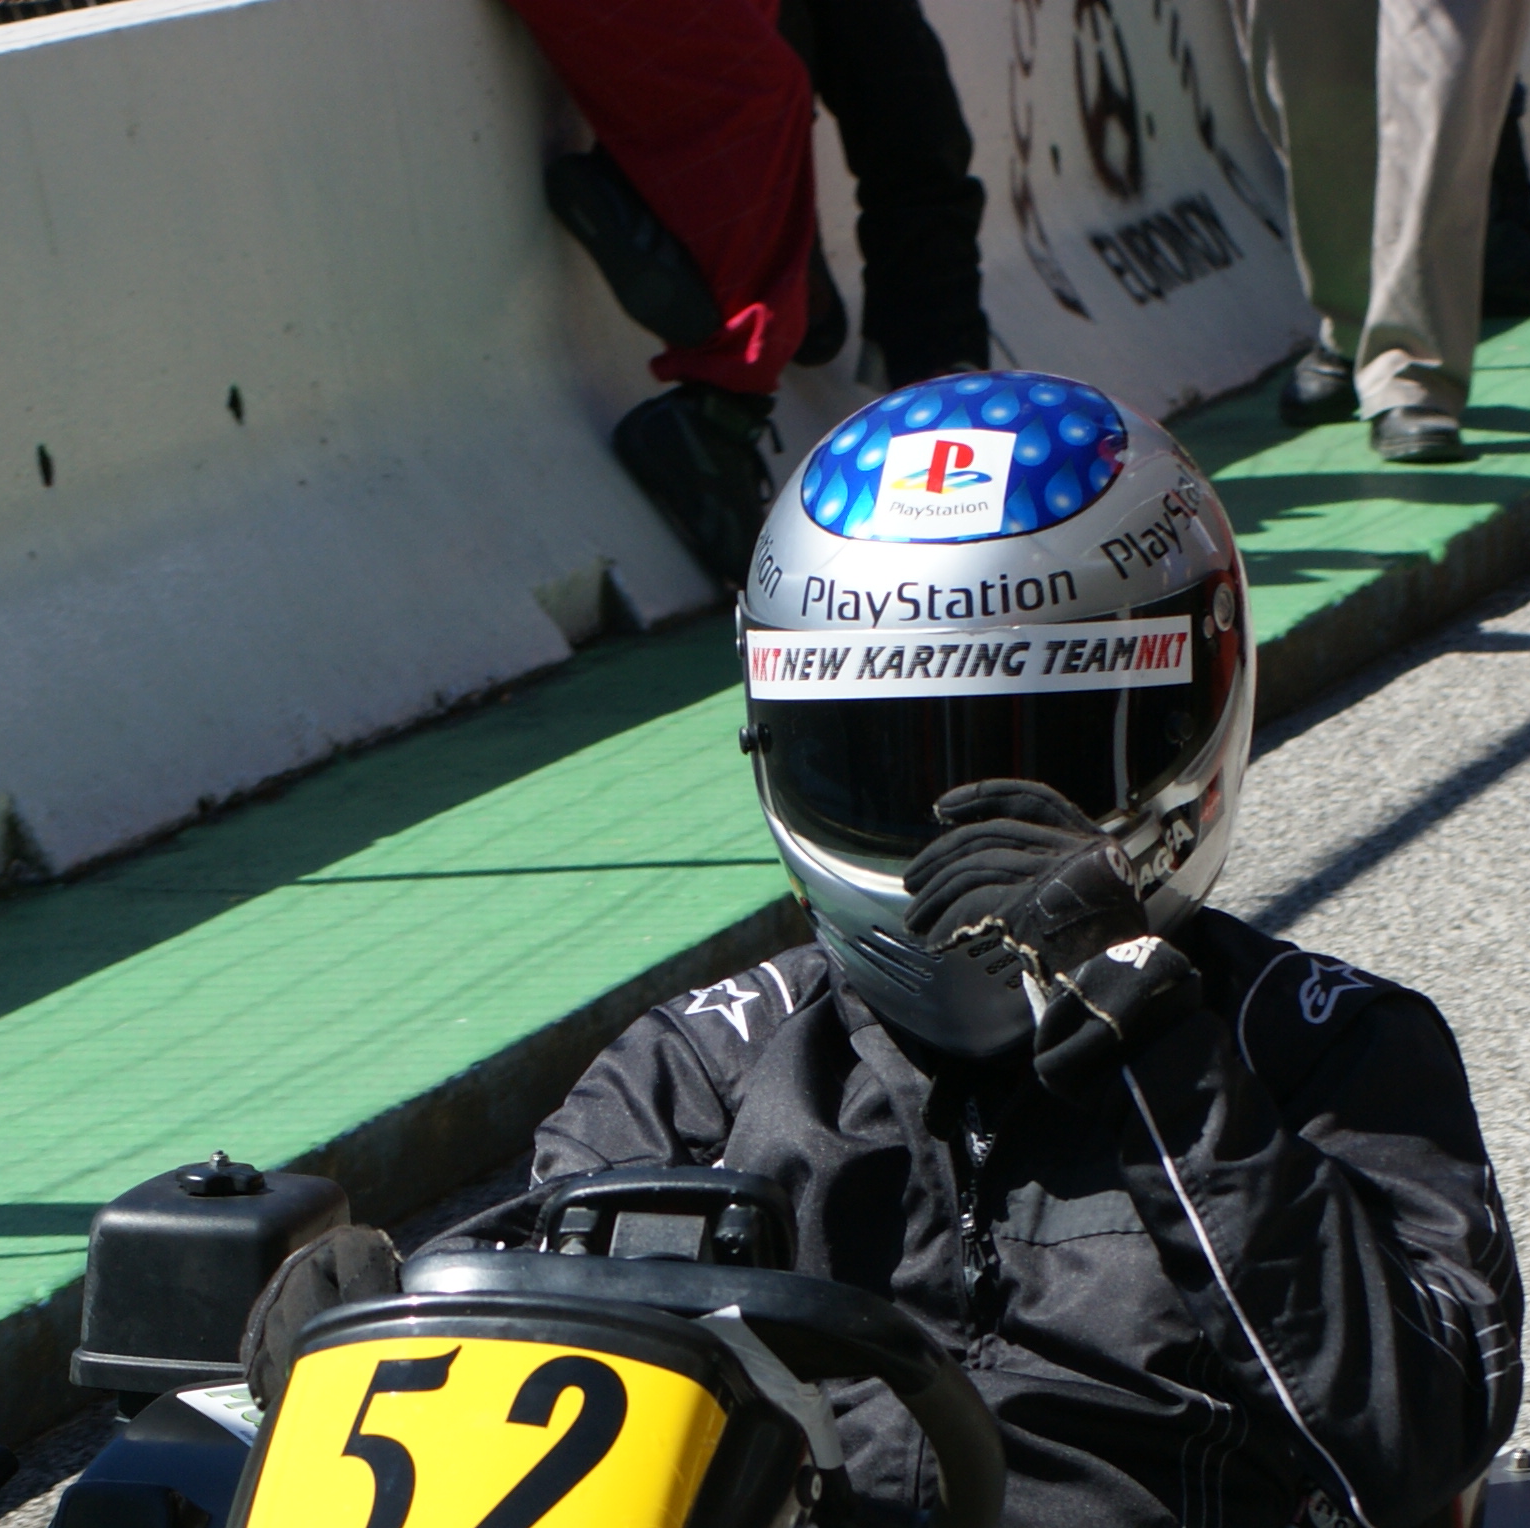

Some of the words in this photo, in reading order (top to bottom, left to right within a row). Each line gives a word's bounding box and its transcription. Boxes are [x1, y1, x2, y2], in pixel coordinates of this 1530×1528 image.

[889, 501, 989, 521] PlayStation
[801, 570, 1078, 629] PlayStation
[856, 642, 1031, 680] KARTING
